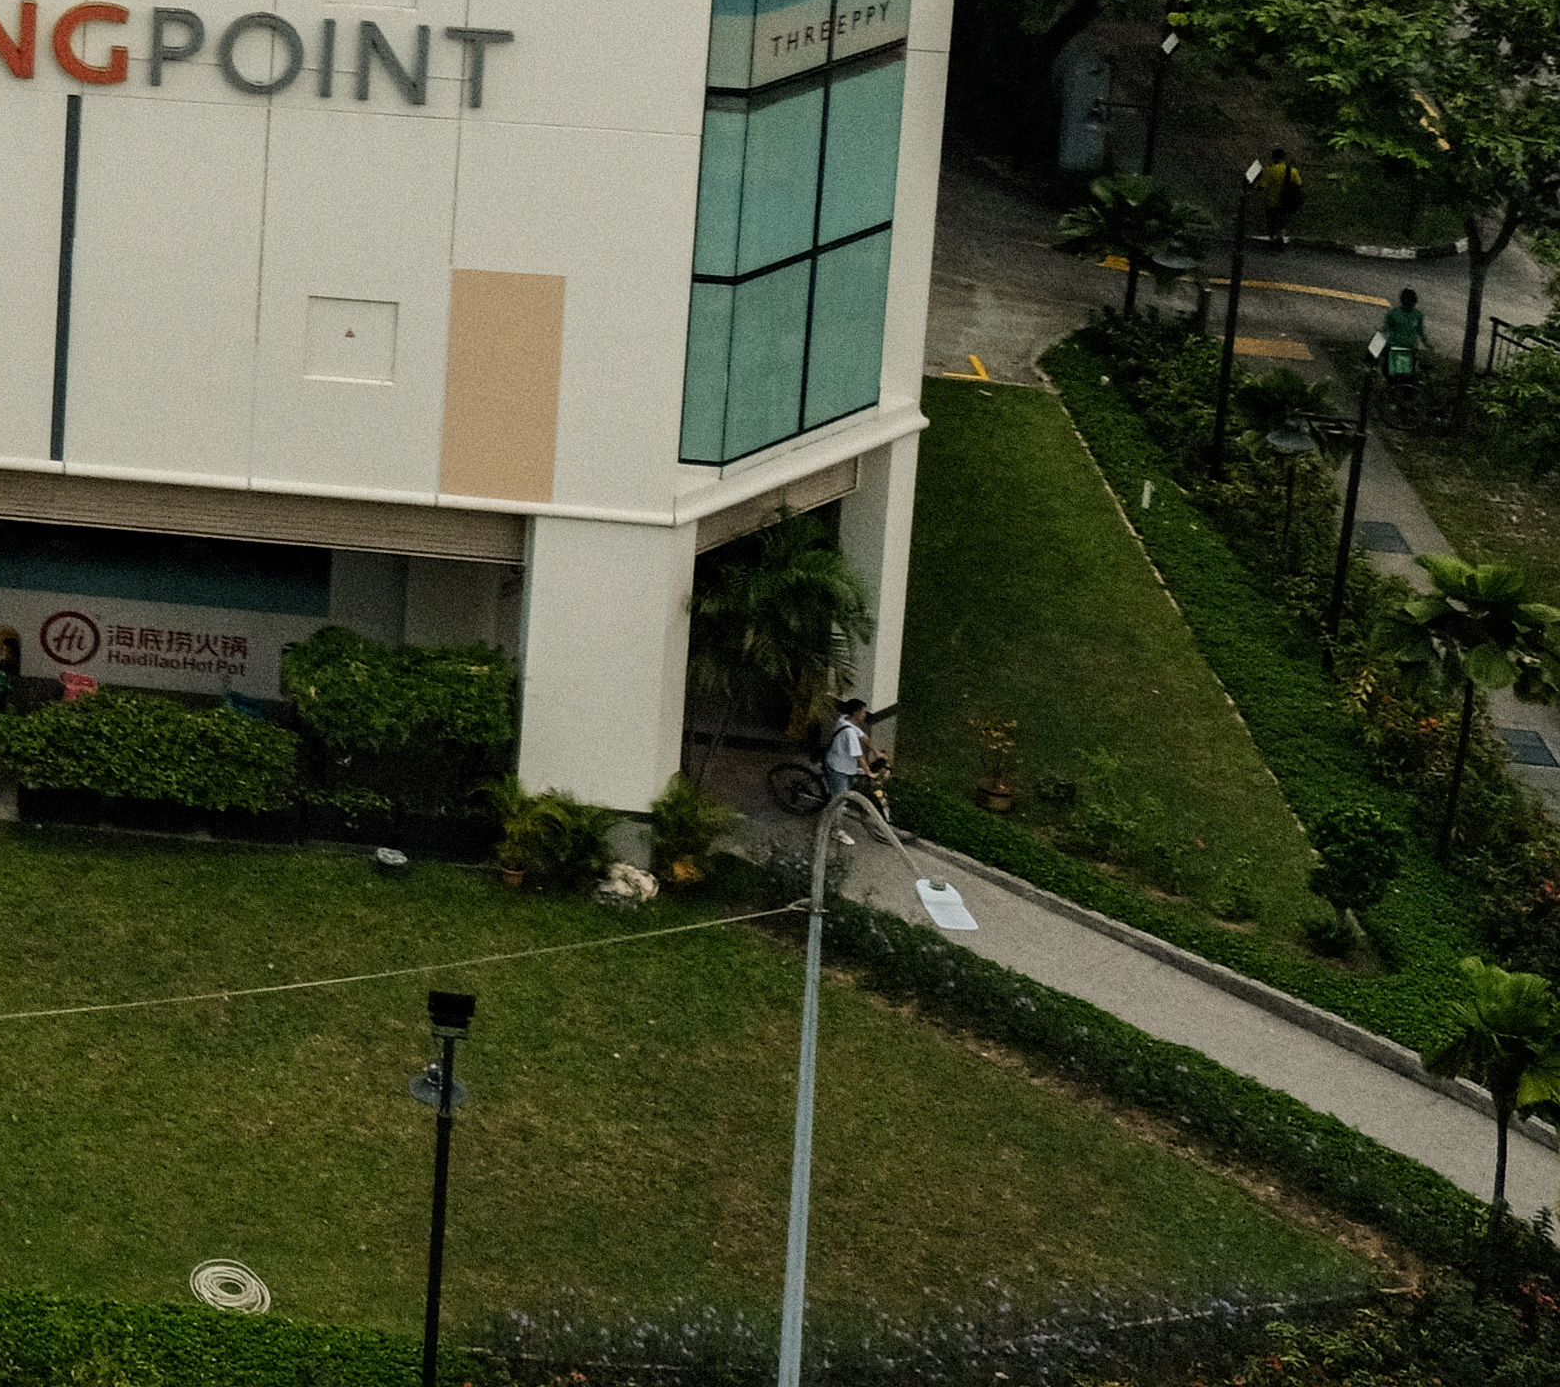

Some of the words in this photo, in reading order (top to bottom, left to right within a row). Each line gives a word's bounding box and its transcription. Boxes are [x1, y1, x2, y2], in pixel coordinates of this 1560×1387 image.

[770, 1, 890, 57] THREEPPY
[107, 625, 248, 659] 海底捞火锅
